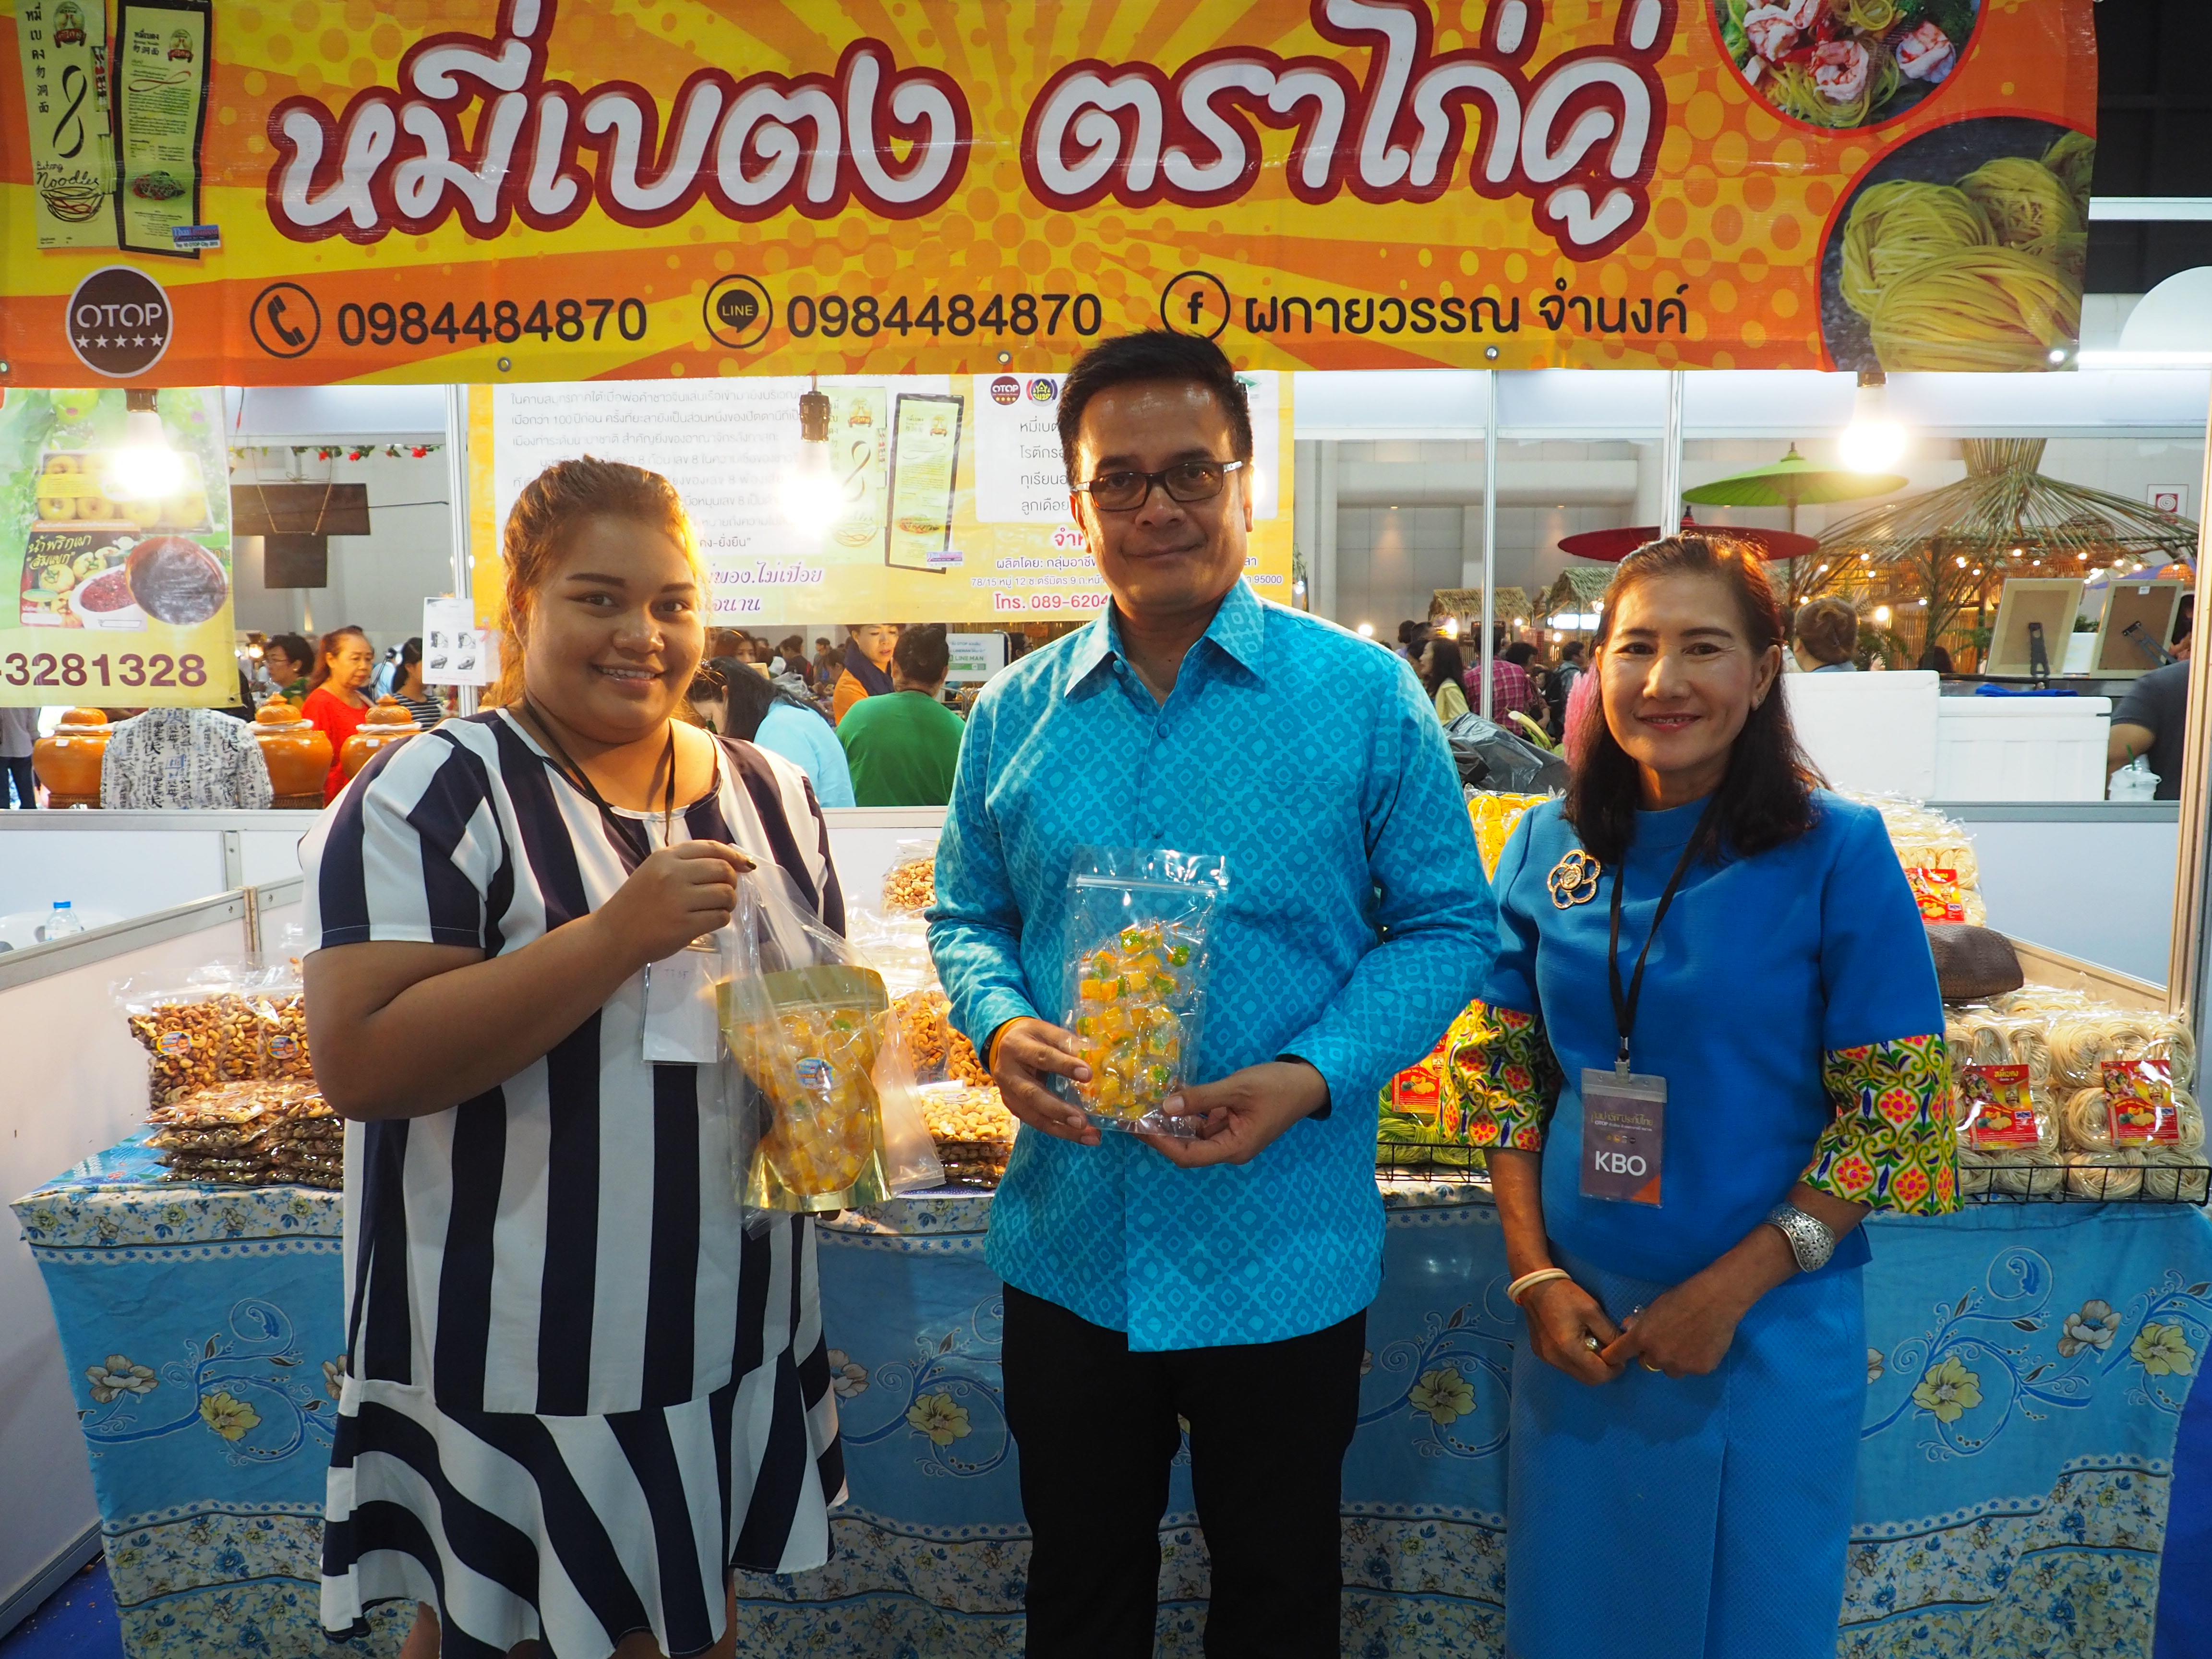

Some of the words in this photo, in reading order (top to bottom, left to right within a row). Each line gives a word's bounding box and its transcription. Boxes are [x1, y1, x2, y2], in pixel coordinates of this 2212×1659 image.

[275, 0, 964, 234] หมี่เบตง
[1028, 0, 1660, 253] ตราไก่คู่
[36, 170, 99, 189] Noodles
[721, 304, 755, 317] LINE
[1244, 294, 1521, 336] ผกายวรรณ
[1538, 277, 1689, 334] จำนงค์
[75, 303, 163, 329] OTOP
[337, 298, 648, 347] 0984484870
[786, 293, 1103, 340] 0984484870
[992, 384, 1019, 393] OTOP
[553, 415, 572, 425] 100
[1020, 416, 1060, 433] หมี่เบต
[692, 455, 698, 464] 8
[1020, 445, 1064, 458] โรตีกรอ
[1021, 471, 1068, 489] ทุเรียนอ
[684, 492, 735, 509] มื่อหมุนเลข
[1054, 527, 1086, 546] จำห
[997, 556, 1043, 569] ผลิตโดย:
[971, 577, 997, 587] 78/15
[999, 574, 1012, 589] หมู่
[1070, 577, 1076, 585] 9
[1254, 575, 1282, 583] 95000
[995, 593, 1026, 609] โทร.
[1031, 594, 1108, 608] 089-6204
[0, 652, 207, 687] 3281328
[1595, 1150, 1647, 1177] KBO
